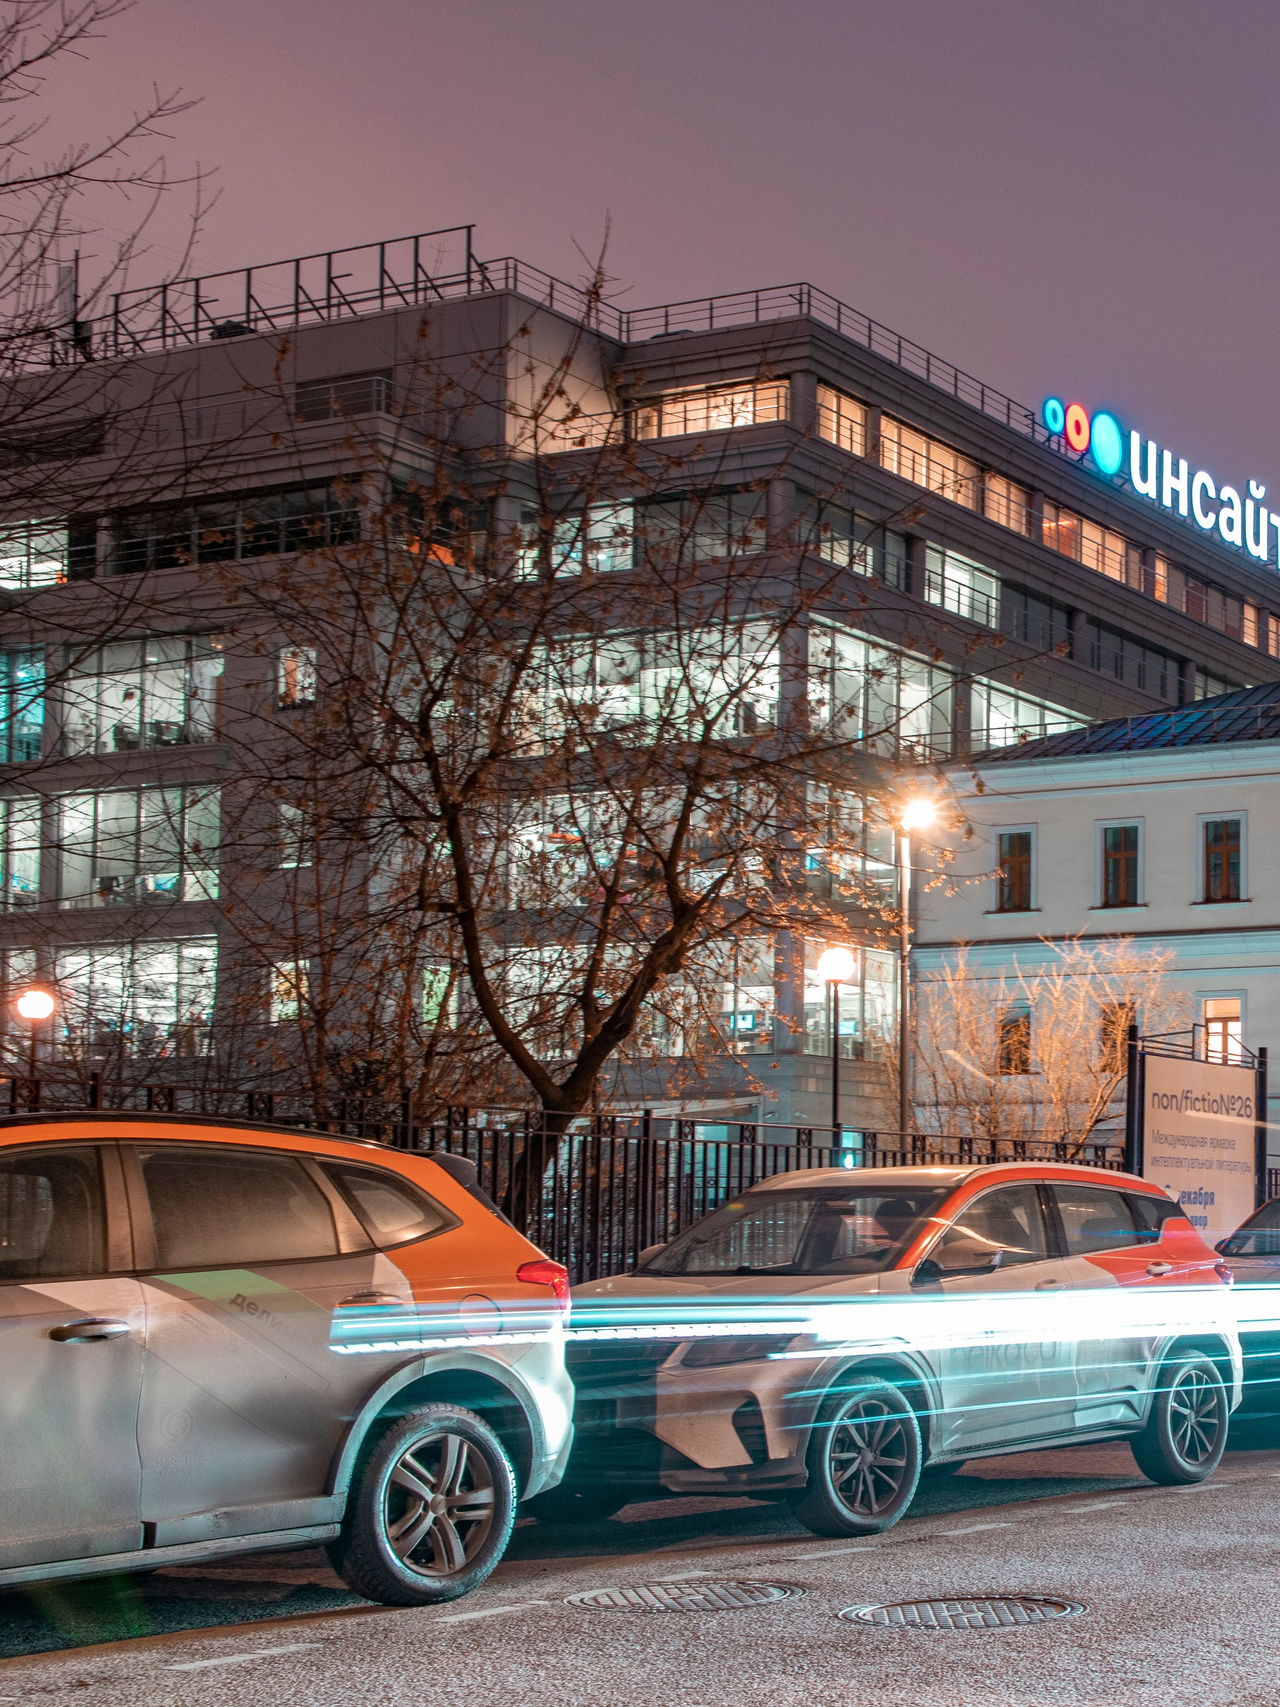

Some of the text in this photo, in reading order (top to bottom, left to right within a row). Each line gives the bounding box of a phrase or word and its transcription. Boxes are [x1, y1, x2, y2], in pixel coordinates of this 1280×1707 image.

[1151, 1129, 1236, 1151] Международная ярмарка
[1151, 1156, 1252, 1175] интеллектуальной литературы
[1180, 1186, 1215, 1210] екабря
